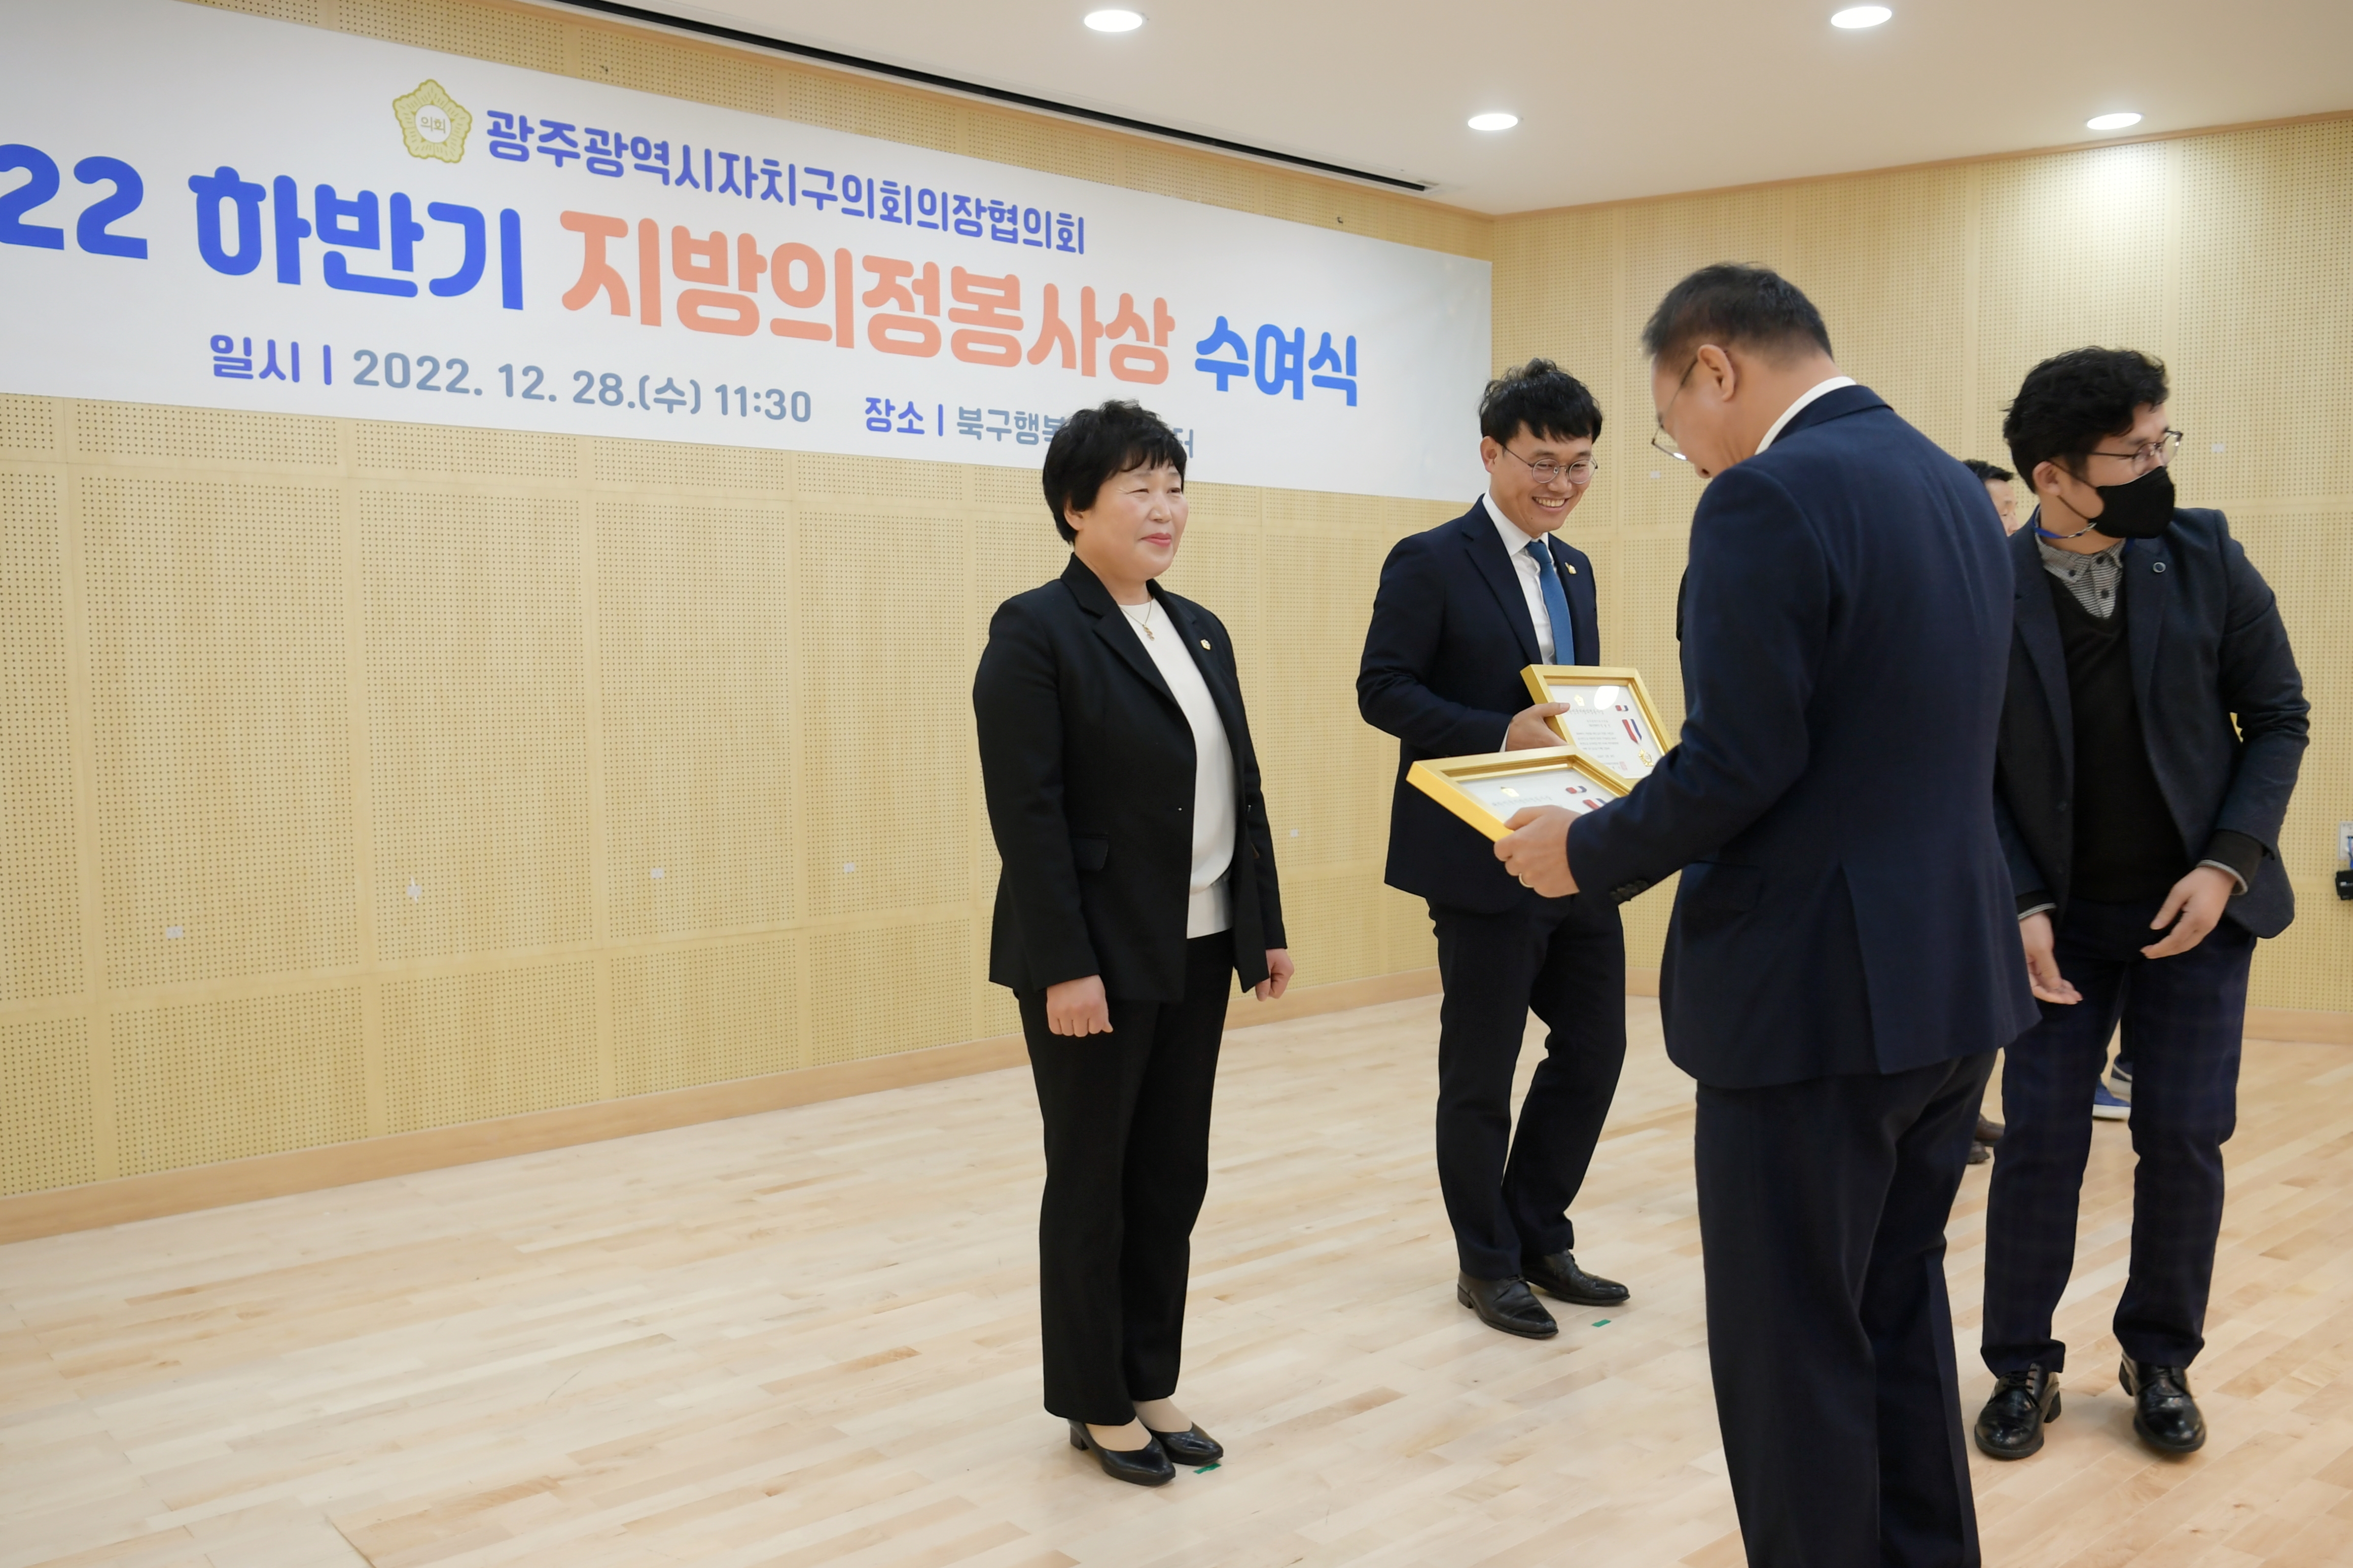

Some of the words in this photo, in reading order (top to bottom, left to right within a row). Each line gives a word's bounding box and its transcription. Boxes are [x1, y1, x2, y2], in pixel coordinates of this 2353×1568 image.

[420, 117, 446, 134] 의회
[487, 110, 1085, 255] 광주광역시자치구의회의장협의회
[188, 166, 524, 311] 하반기
[559, 210, 1176, 386] 지방의정봉사상
[1195, 315, 1358, 408] 수여식
[209, 334, 300, 384] 일시
[353, 349, 483, 396] 2022.
[499, 363, 557, 403] 12.
[715, 383, 811, 422] 11:30
[864, 396, 925, 436] 장소
